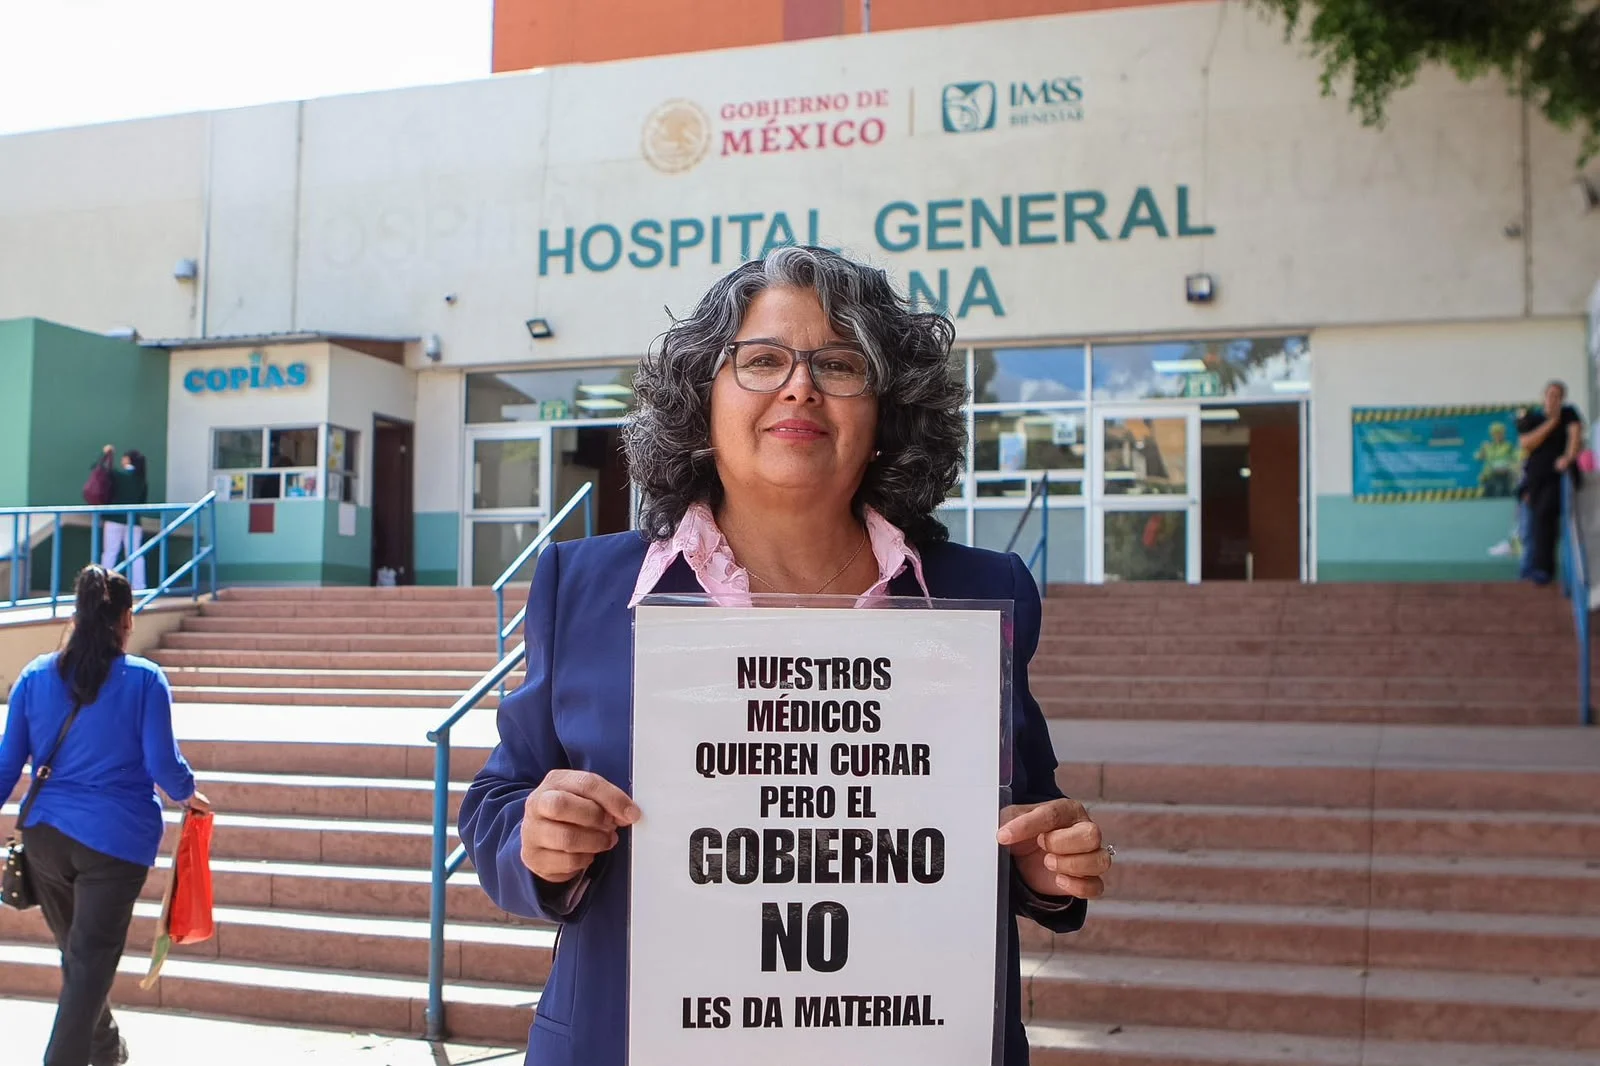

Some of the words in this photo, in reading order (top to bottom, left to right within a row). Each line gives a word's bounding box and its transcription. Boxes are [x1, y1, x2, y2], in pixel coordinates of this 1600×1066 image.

[720, 92, 849, 121] GOBIERNO
[856, 89, 889, 108] DE
[1009, 76, 1083, 107] IMSS
[720, 119, 887, 157] MÉXICO
[538, 208, 842, 277] HOSPITAL
[874, 184, 1216, 253] GENERAL
[908, 265, 1006, 319] NA
[183, 352, 307, 393] COPIAS
[737, 656, 892, 691] NUESTROS
[747, 693, 881, 733] MÉDICOS
[695, 742, 818, 778] QUIEREN
[830, 743, 931, 777] CURAR
[760, 785, 836, 819] PERO
[847, 786, 877, 819] EL
[688, 827, 946, 885] GOBIERNO
[760, 900, 849, 973] NO
[682, 996, 731, 1029] LES
[742, 996, 784, 1028] DA
[794, 995, 945, 1028] MATERIAL.
